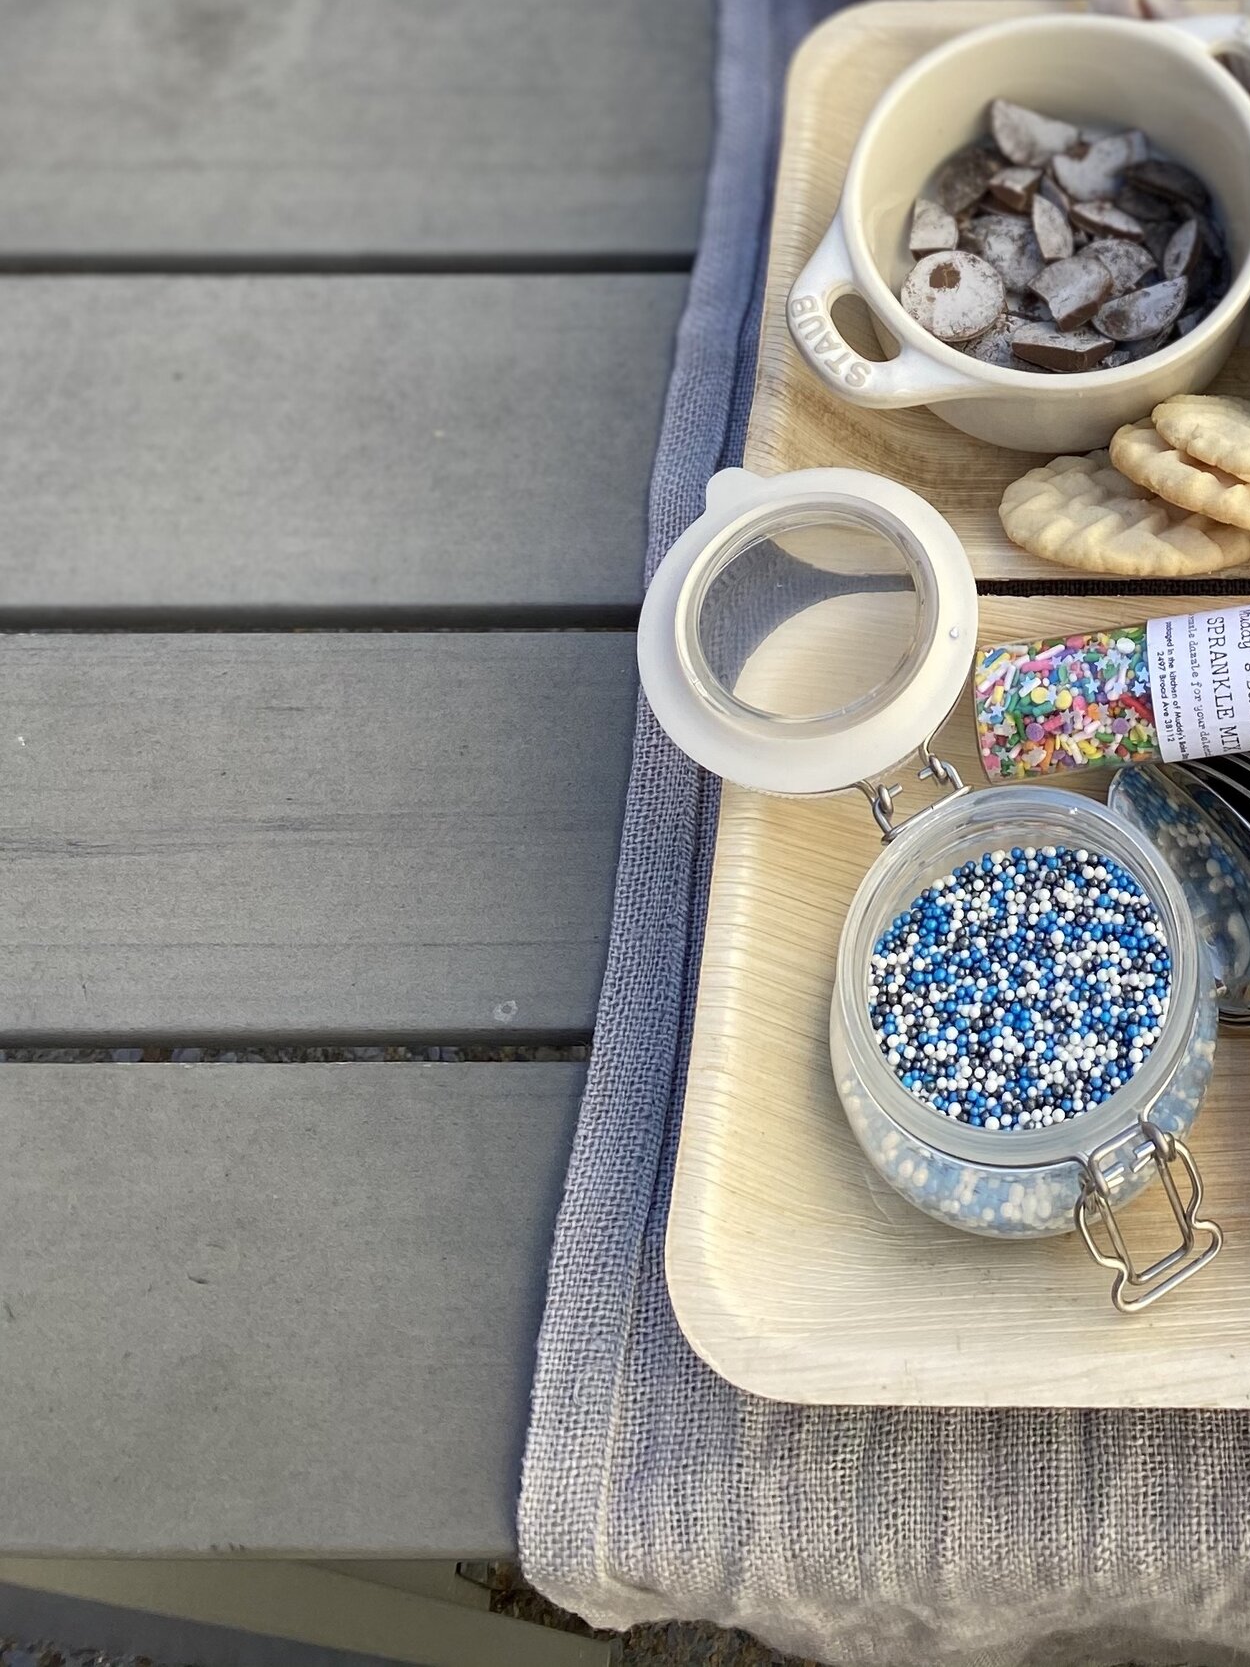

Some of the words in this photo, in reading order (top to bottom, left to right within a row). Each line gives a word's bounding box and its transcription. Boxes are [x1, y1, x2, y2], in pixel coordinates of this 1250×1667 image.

[790, 295, 872, 388] STAUB
[1157, 652, 1165, 672] 2497
[1188, 641, 1201, 678] dazzle
[1207, 617, 1235, 719] SPRANKLE
[1159, 675, 1168, 698] Broad
[1170, 671, 1179, 699] kitchen
[1191, 681, 1203, 702] for
[1162, 702, 1170, 716] Ave
[1172, 701, 1180, 709] of
[1193, 706, 1206, 729] your
[1165, 720, 1175, 742] 38112
[1219, 726, 1241, 753] MIX
